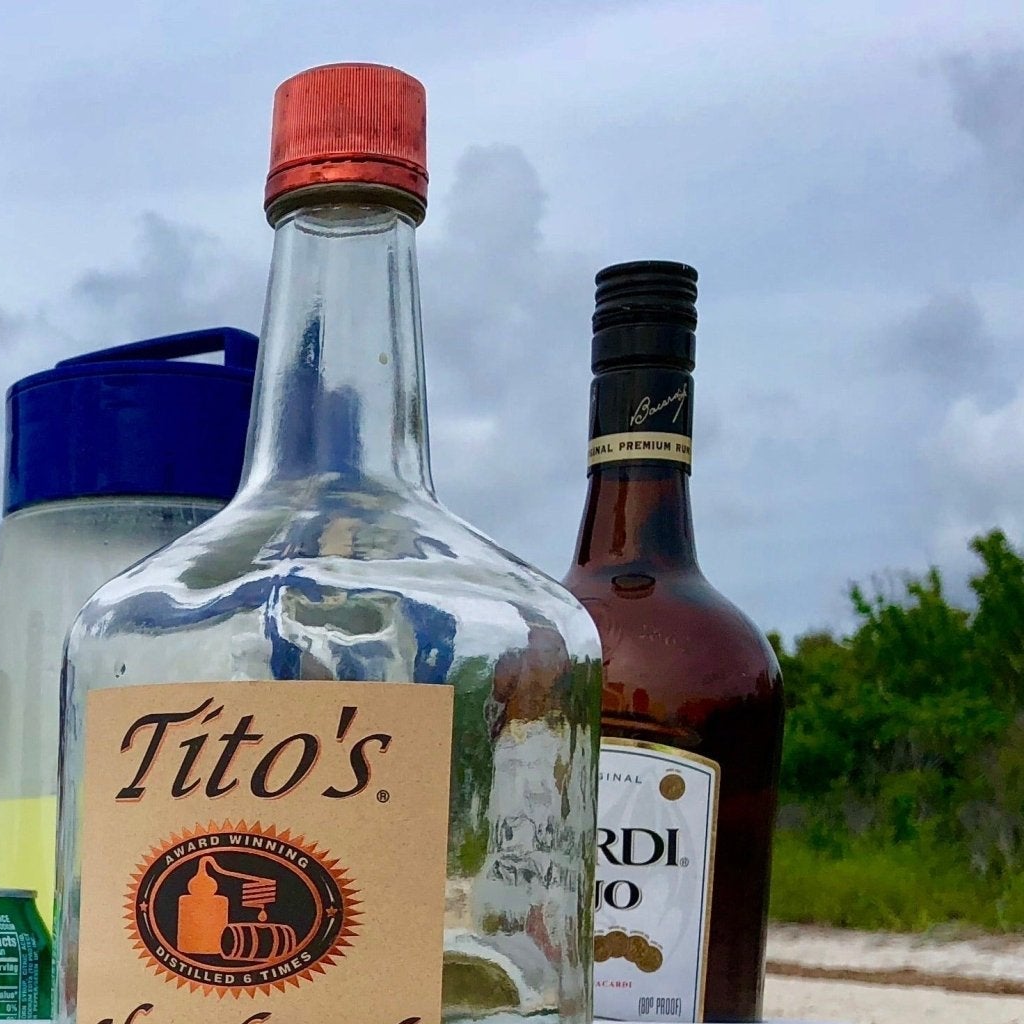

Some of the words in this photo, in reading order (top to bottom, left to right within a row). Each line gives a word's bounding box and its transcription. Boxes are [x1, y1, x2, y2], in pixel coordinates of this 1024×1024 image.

[619, 440, 671, 451] PREMIUM
[115, 697, 392, 802] Tito's
[165, 836, 220, 865] AWARD
[229, 835, 309, 869] WINNING
[156, 946, 235, 983] DISTILLED
[244, 974, 252, 983] 6
[260, 951, 311, 981] TIMES
[6, 1004, 17, 1012] 0%
[656, 997, 682, 1017] PROOF)
